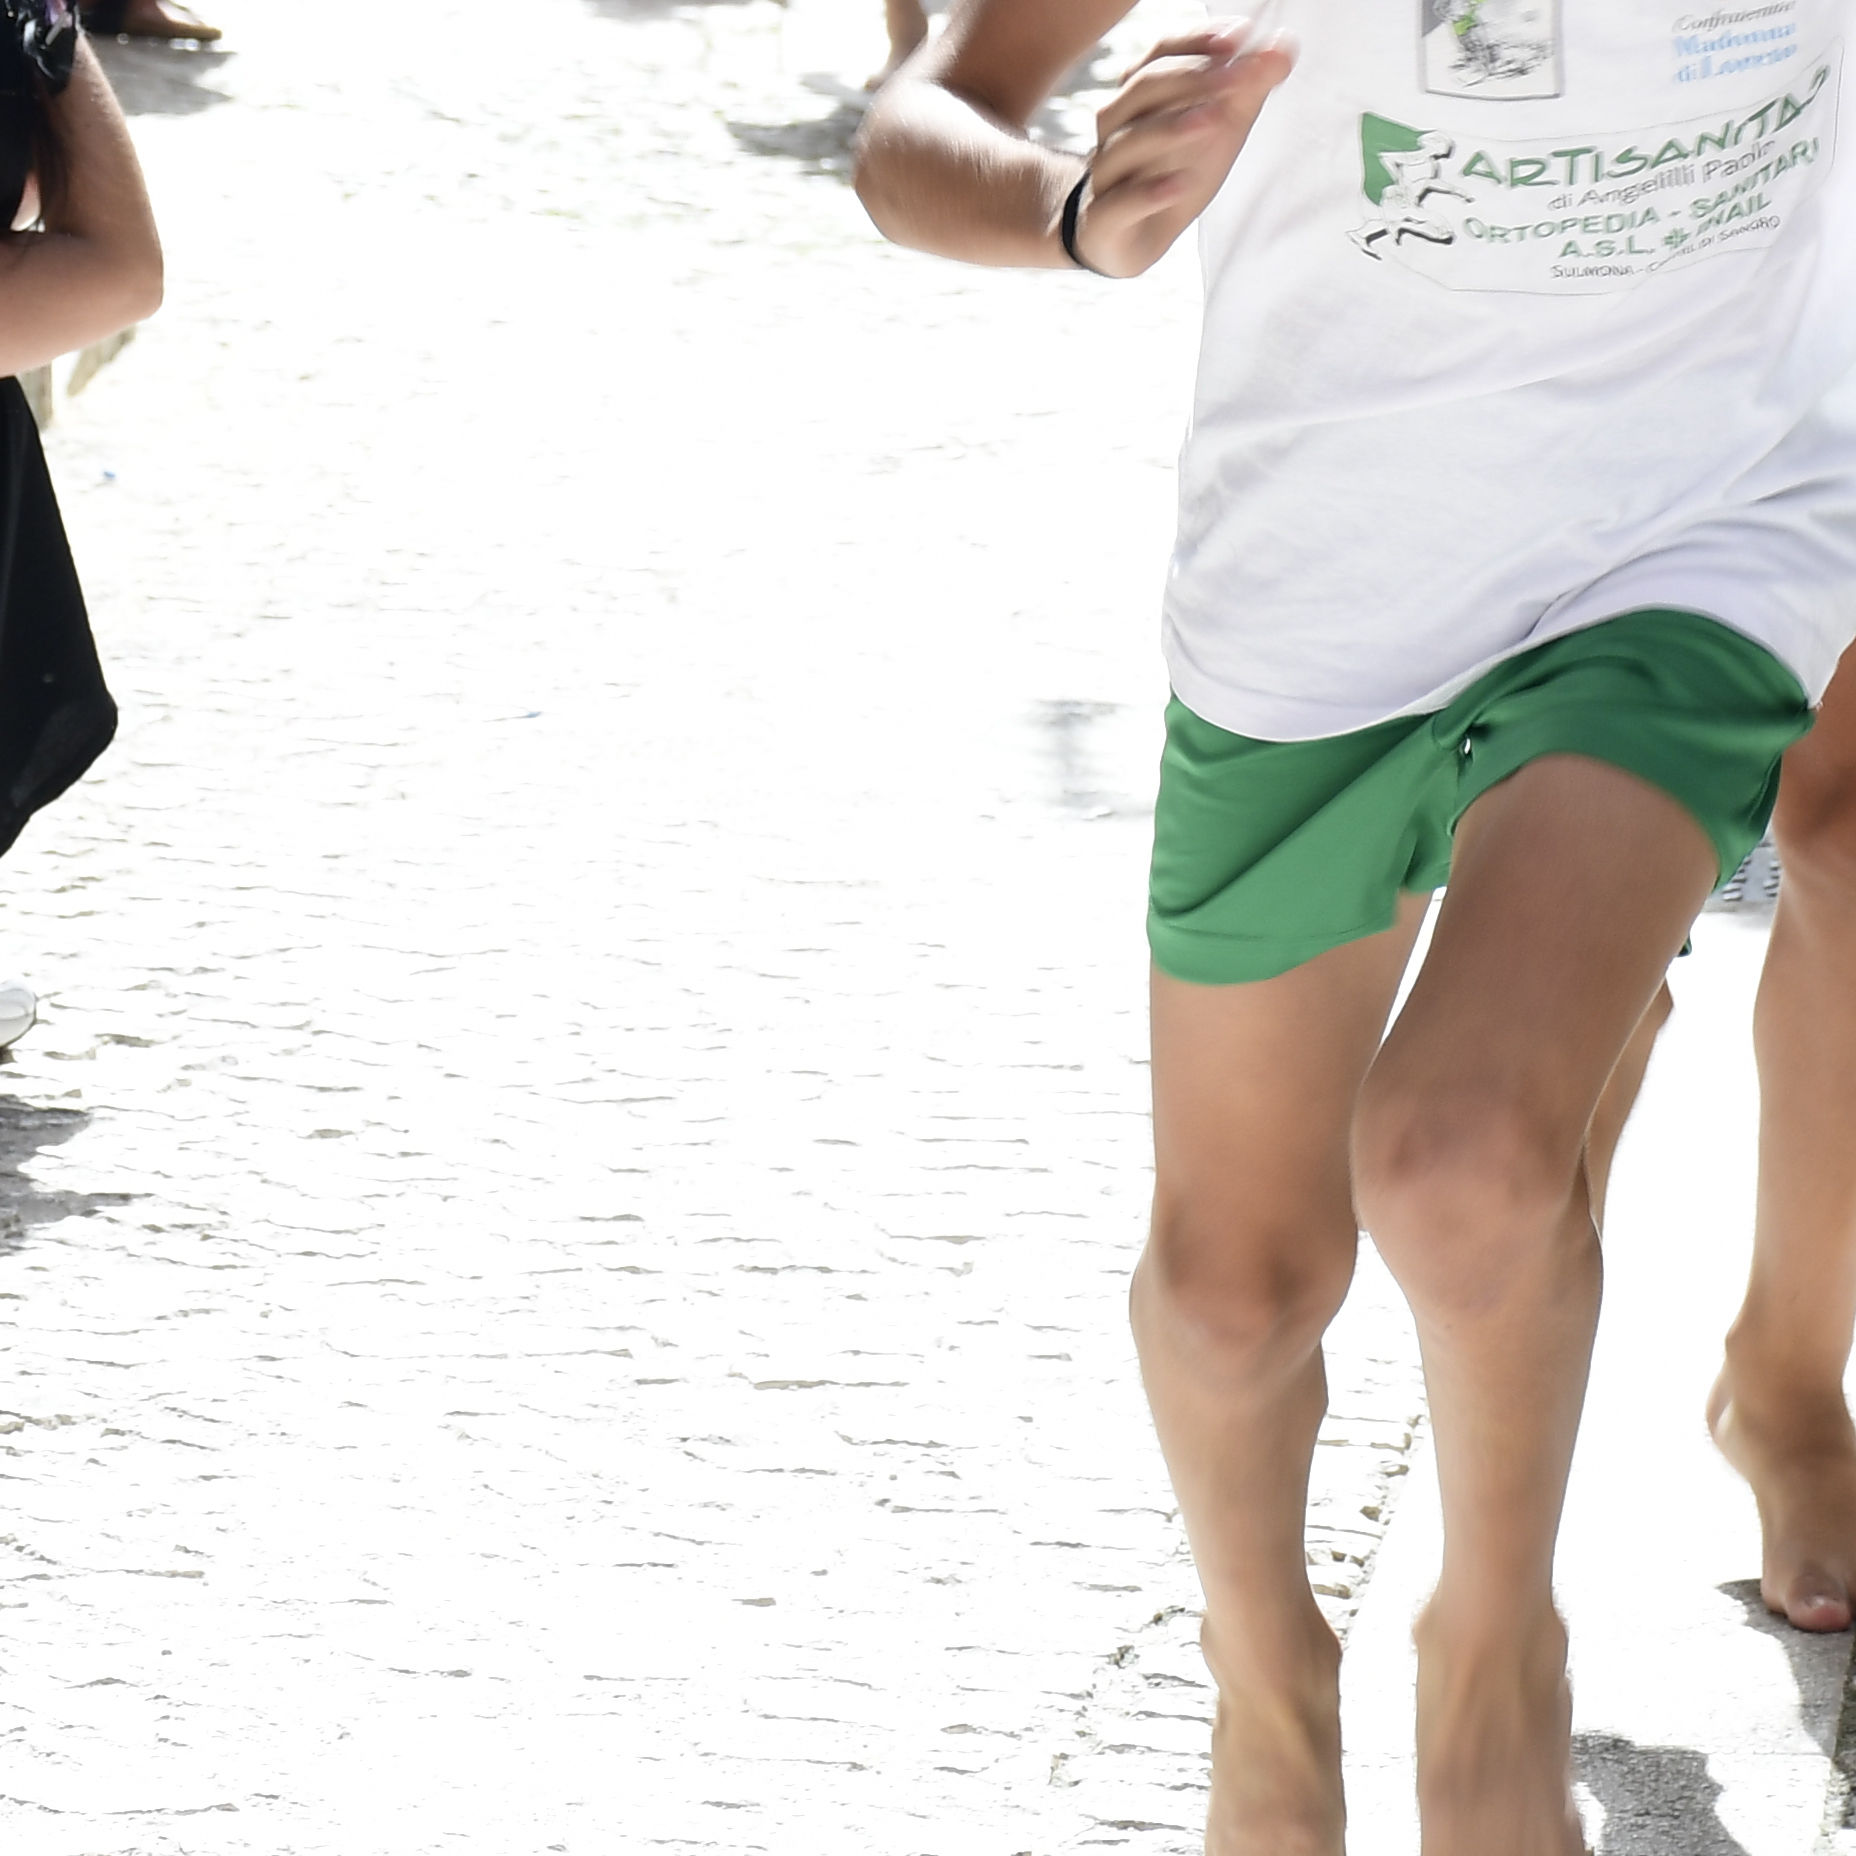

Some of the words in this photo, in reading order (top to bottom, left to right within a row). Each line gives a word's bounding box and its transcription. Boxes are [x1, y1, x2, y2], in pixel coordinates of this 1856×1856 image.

[1463, 206, 1662, 244] ORTOPEDIA
[1689, 136, 1821, 219] SANITARI
[1547, 194, 1574, 211] di
